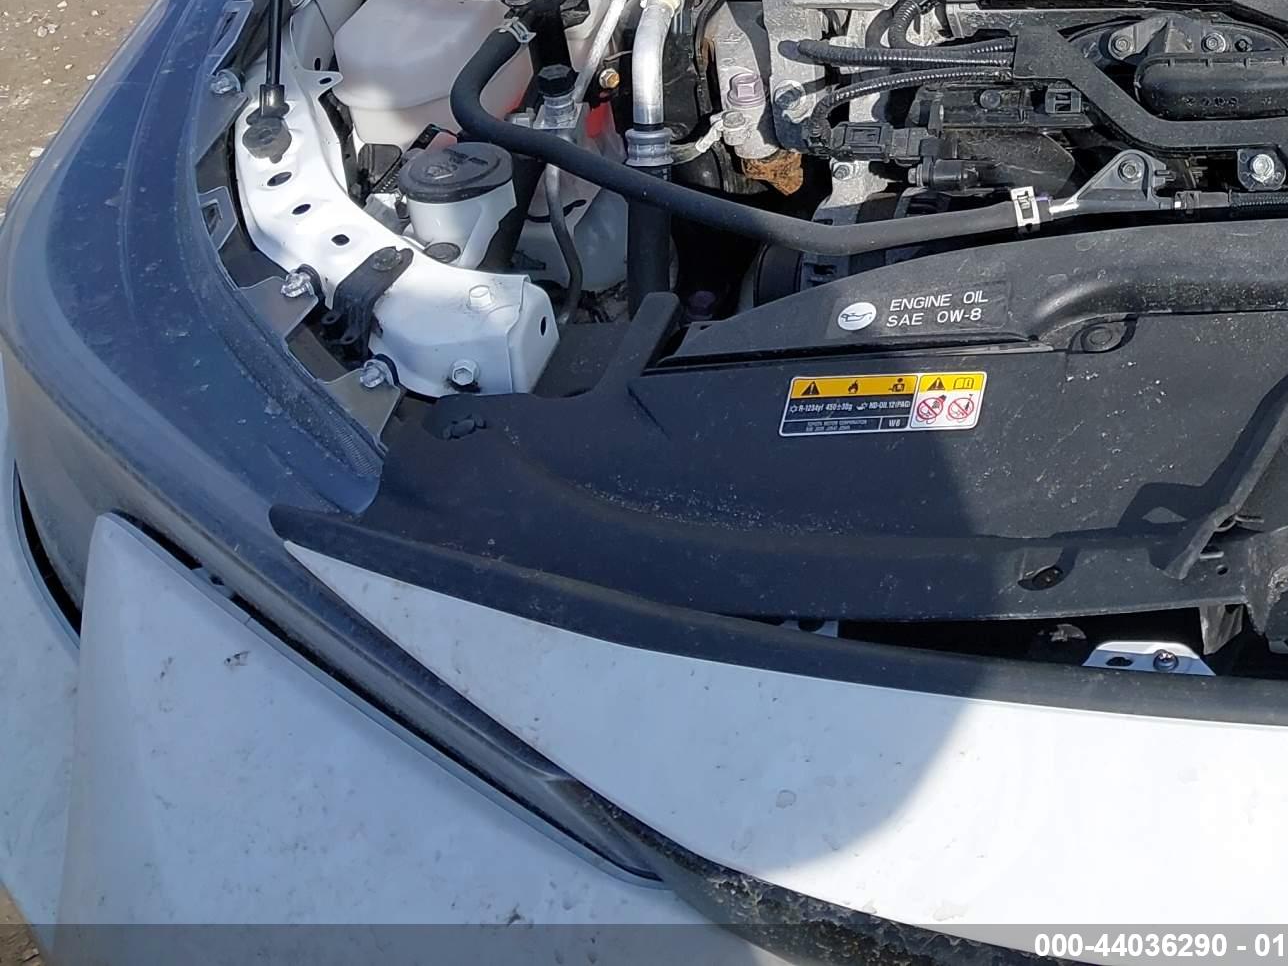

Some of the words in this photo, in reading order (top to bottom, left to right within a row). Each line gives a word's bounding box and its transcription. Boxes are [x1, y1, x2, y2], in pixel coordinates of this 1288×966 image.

[889, 293, 953, 311] ENGINE
[963, 290, 989, 304] OIL
[886, 312, 924, 327] SAE
[936, 307, 982, 323] 0W-8
